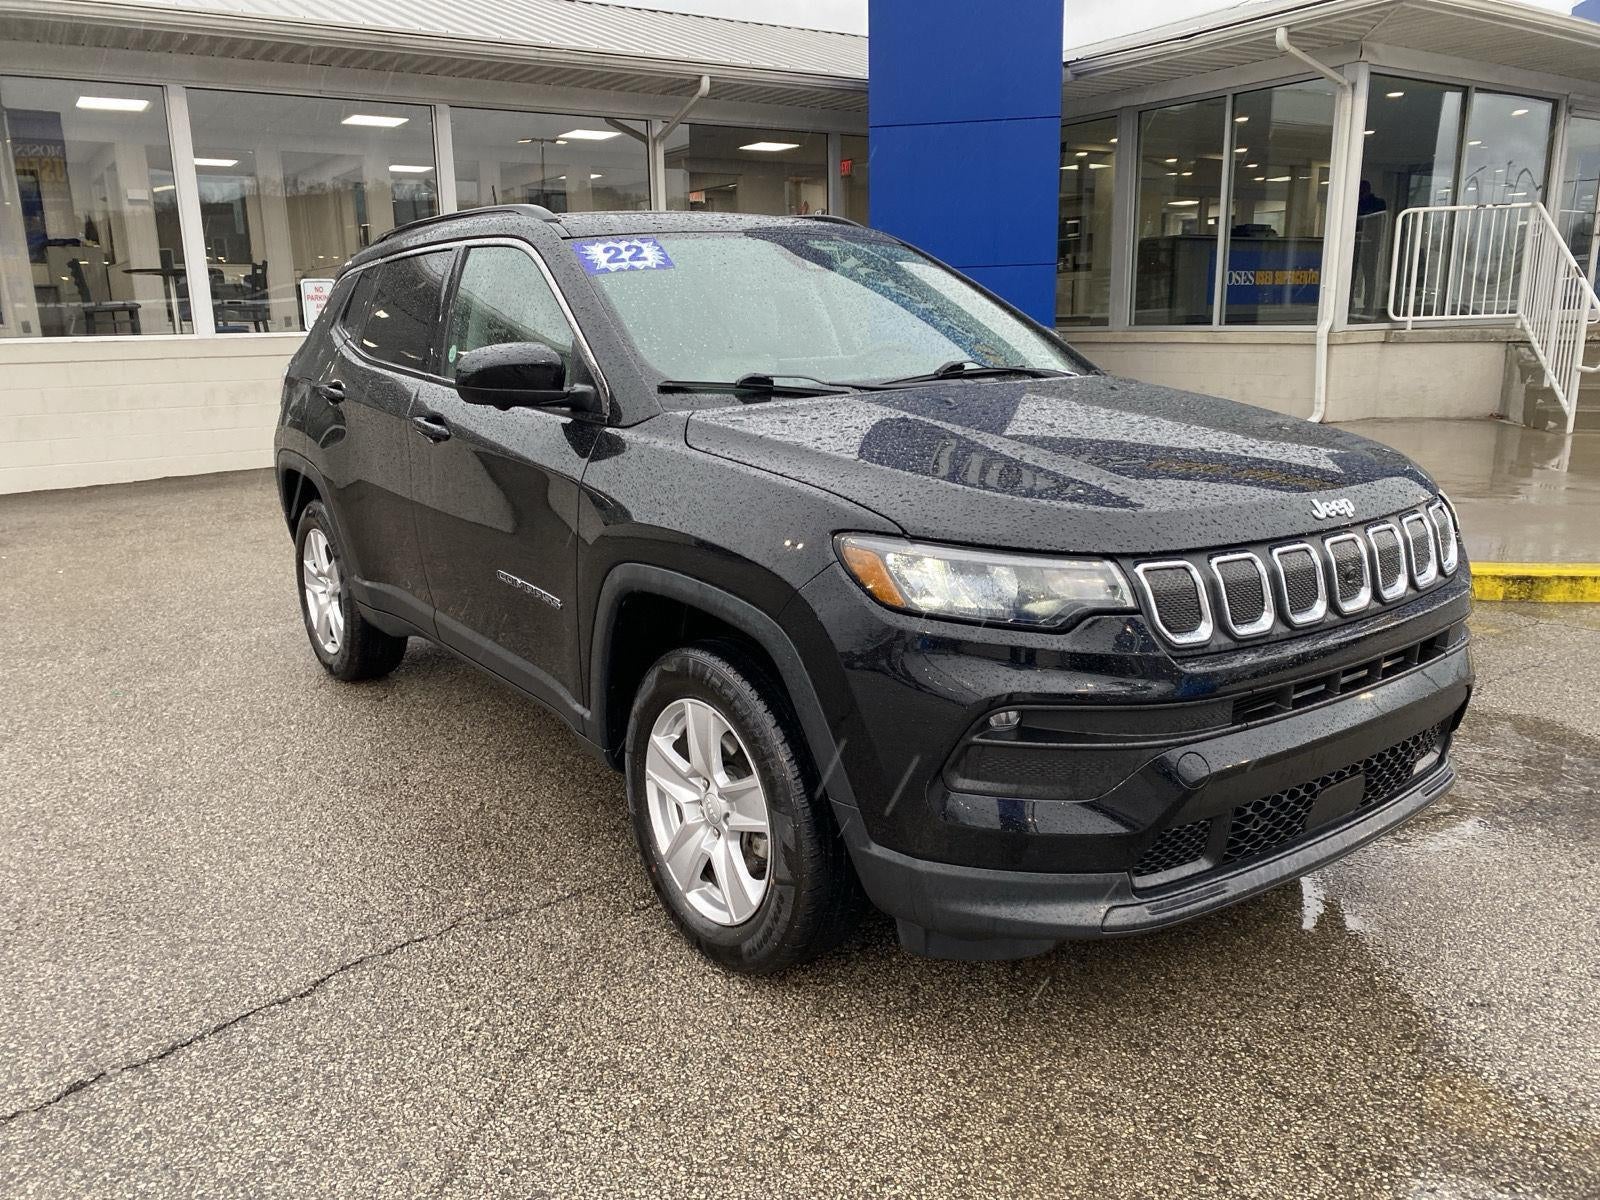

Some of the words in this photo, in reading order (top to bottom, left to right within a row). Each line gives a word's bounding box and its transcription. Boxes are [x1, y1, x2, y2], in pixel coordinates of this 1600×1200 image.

[603, 245, 648, 263] 22
[1225, 271, 1255, 286] OSES
[1255, 270, 1273, 285] USED
[1310, 498, 1356, 520] Jeep
